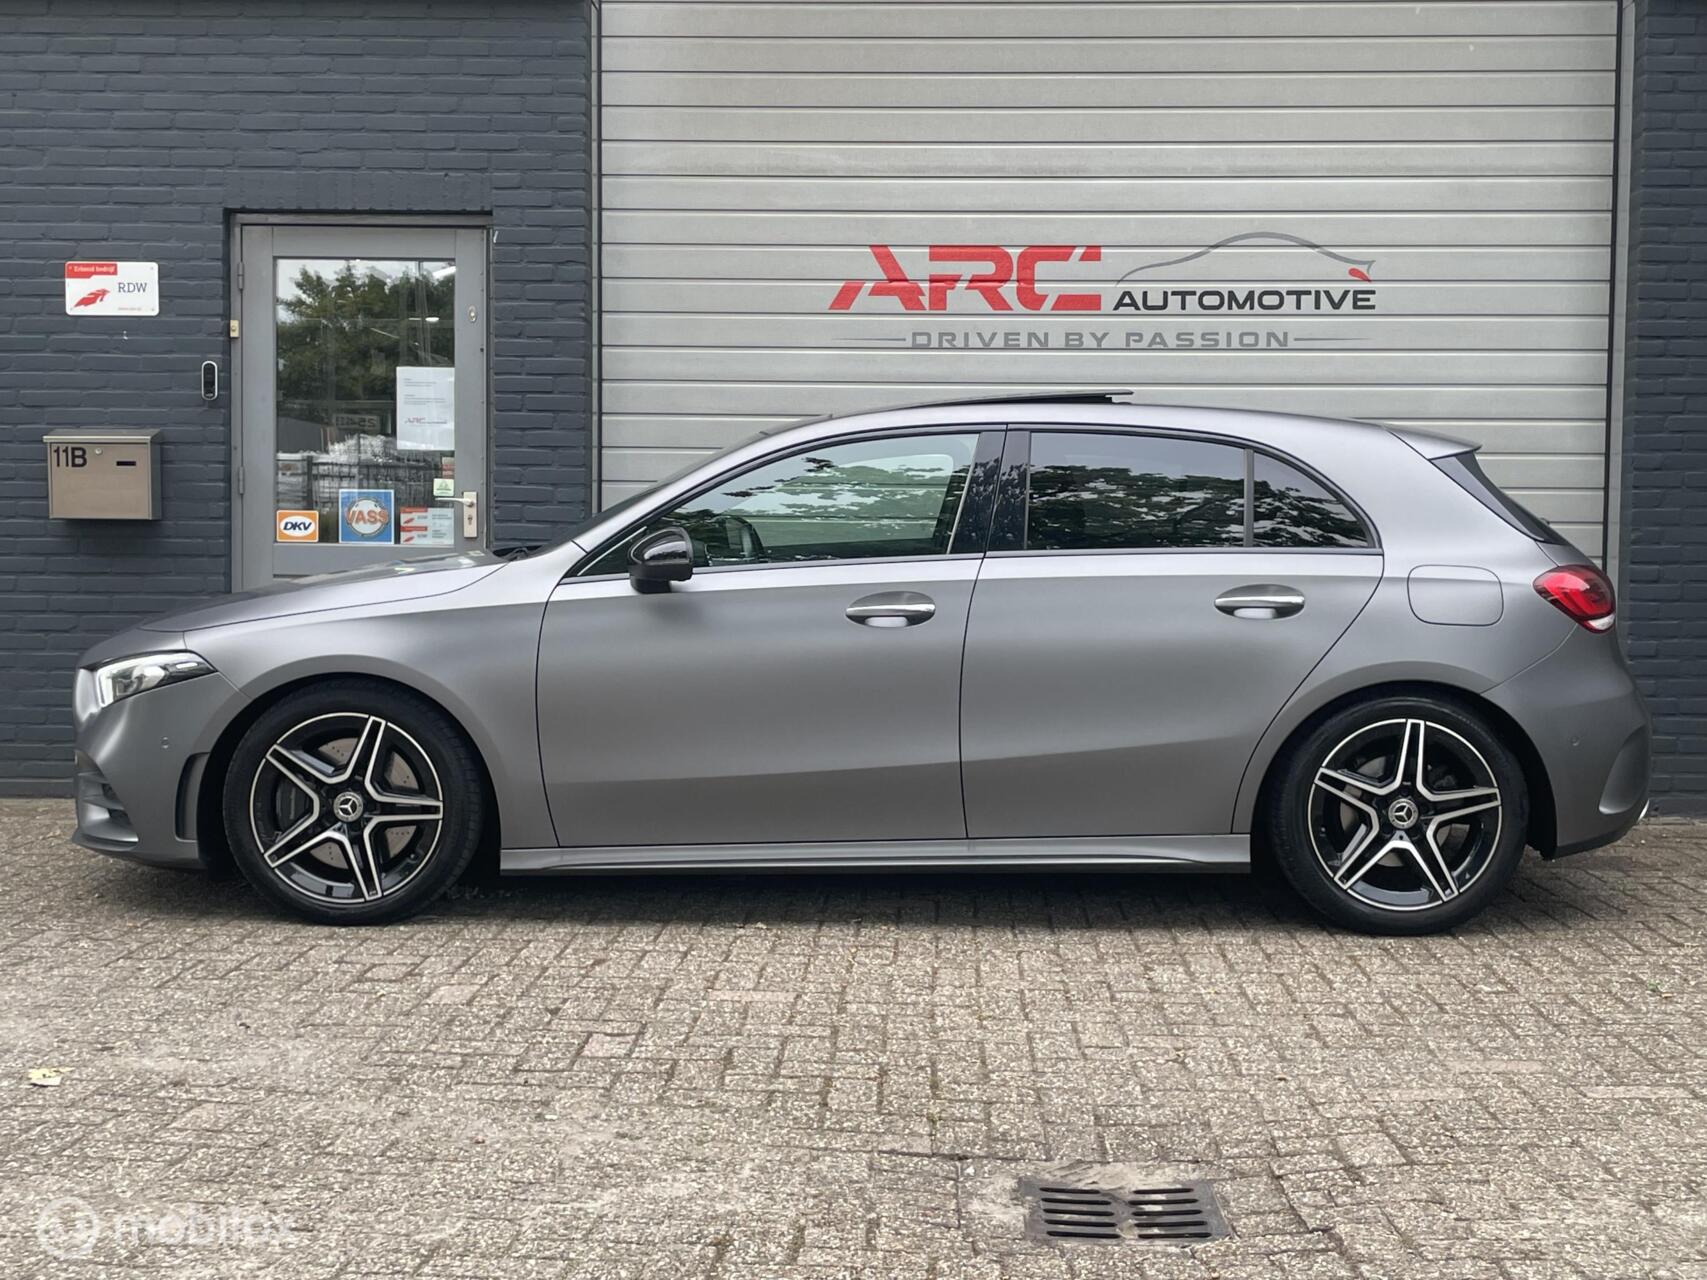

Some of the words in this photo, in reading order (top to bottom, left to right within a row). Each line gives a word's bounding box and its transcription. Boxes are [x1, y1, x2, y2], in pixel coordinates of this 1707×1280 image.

[828, 245, 1102, 311] ARC
[1112, 289, 1377, 311] AUTOMOTIVE
[117, 282, 148, 293] RDW
[911, 331, 1049, 348] DRIVEN
[1064, 331, 1110, 348] BY
[1125, 331, 1289, 348] PASSION
[53, 446, 88, 468] 11B
[282, 521, 313, 531] DKV
